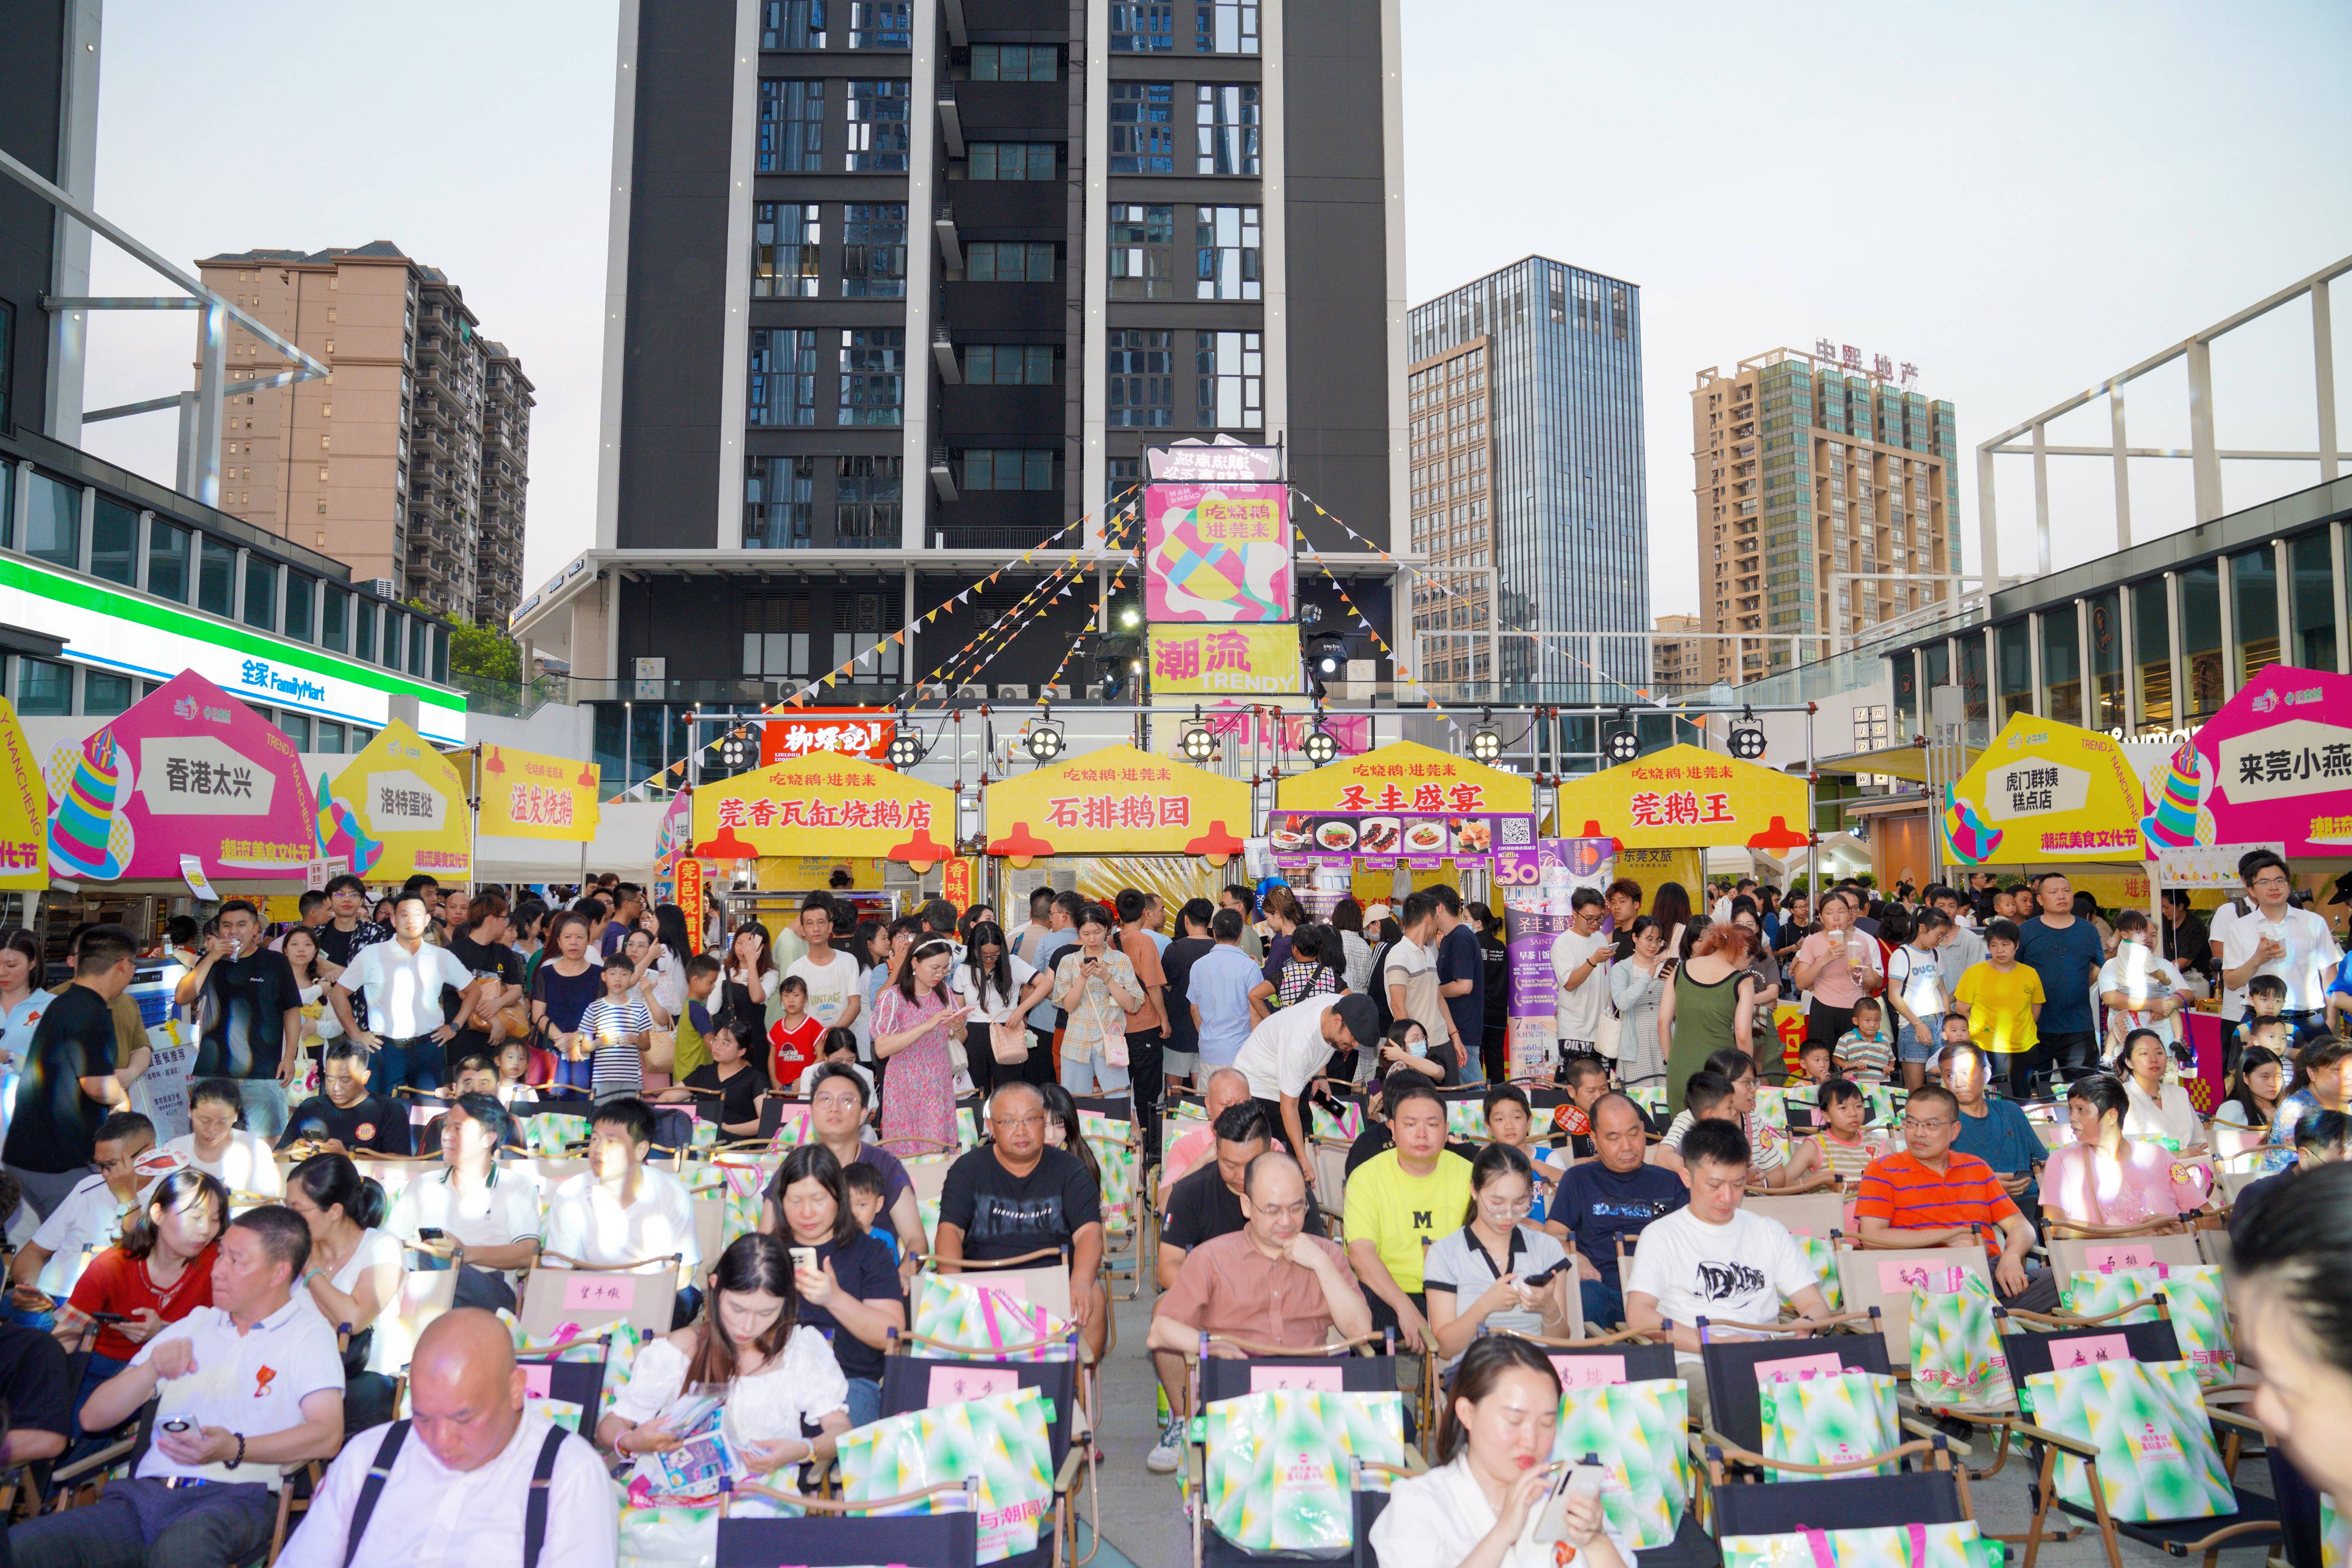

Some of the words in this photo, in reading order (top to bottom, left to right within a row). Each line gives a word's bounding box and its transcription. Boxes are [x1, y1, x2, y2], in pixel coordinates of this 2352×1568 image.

[1205, 503, 1270, 520] 吃烧鹅
[1205, 521, 1270, 539] 进莞来
[1155, 628, 1252, 681] 潮流
[242, 660, 269, 687] 全家
[270, 673, 325, 703] FamilyMart
[1199, 673, 1295, 693] TRENDY
[1063, 767, 1172, 782] 吃烧鹅·进莞来
[1352, 763, 1457, 777] 吃烧鹅·进莞来
[1631, 766, 1734, 780] 吃烧鹅·进莞来
[2239, 743, 2352, 785] 来莞小燕
[4, 731, 42, 837] NANCHENG
[166, 757, 252, 799] 香港太兴
[769, 772, 877, 787] 吃烧鹅·进莞来
[2006, 767, 2059, 792] 虎门群姨
[2081, 738, 2114, 753] TRENDY
[2110, 755, 2140, 824] NANCHENG
[292, 762, 313, 840] NANCHENG
[380, 787, 433, 818] 洛特蛋挞
[510, 784, 573, 827] 溢发烧鹅
[1336, 783, 1485, 813] 圣丰盛宴
[1631, 791, 1735, 828] 莞鹅王
[2013, 789, 2052, 812] 糕点店
[719, 797, 933, 830] 莞香瓦缸烧鹅店
[1045, 795, 1191, 829] 石排鹅园
[220, 837, 311, 864] 潮流美食文化节
[2041, 828, 2138, 851] 潮流美食文化节
[415, 850, 469, 869] 潮流美食文化节
[1623, 850, 1672, 862] 东莞文旅
[1501, 858, 1538, 884] 30
[810, 991, 841, 1006] VINTAGE
[1514, 1017, 1522, 1030] 7
[1412, 1211, 1433, 1229] M
